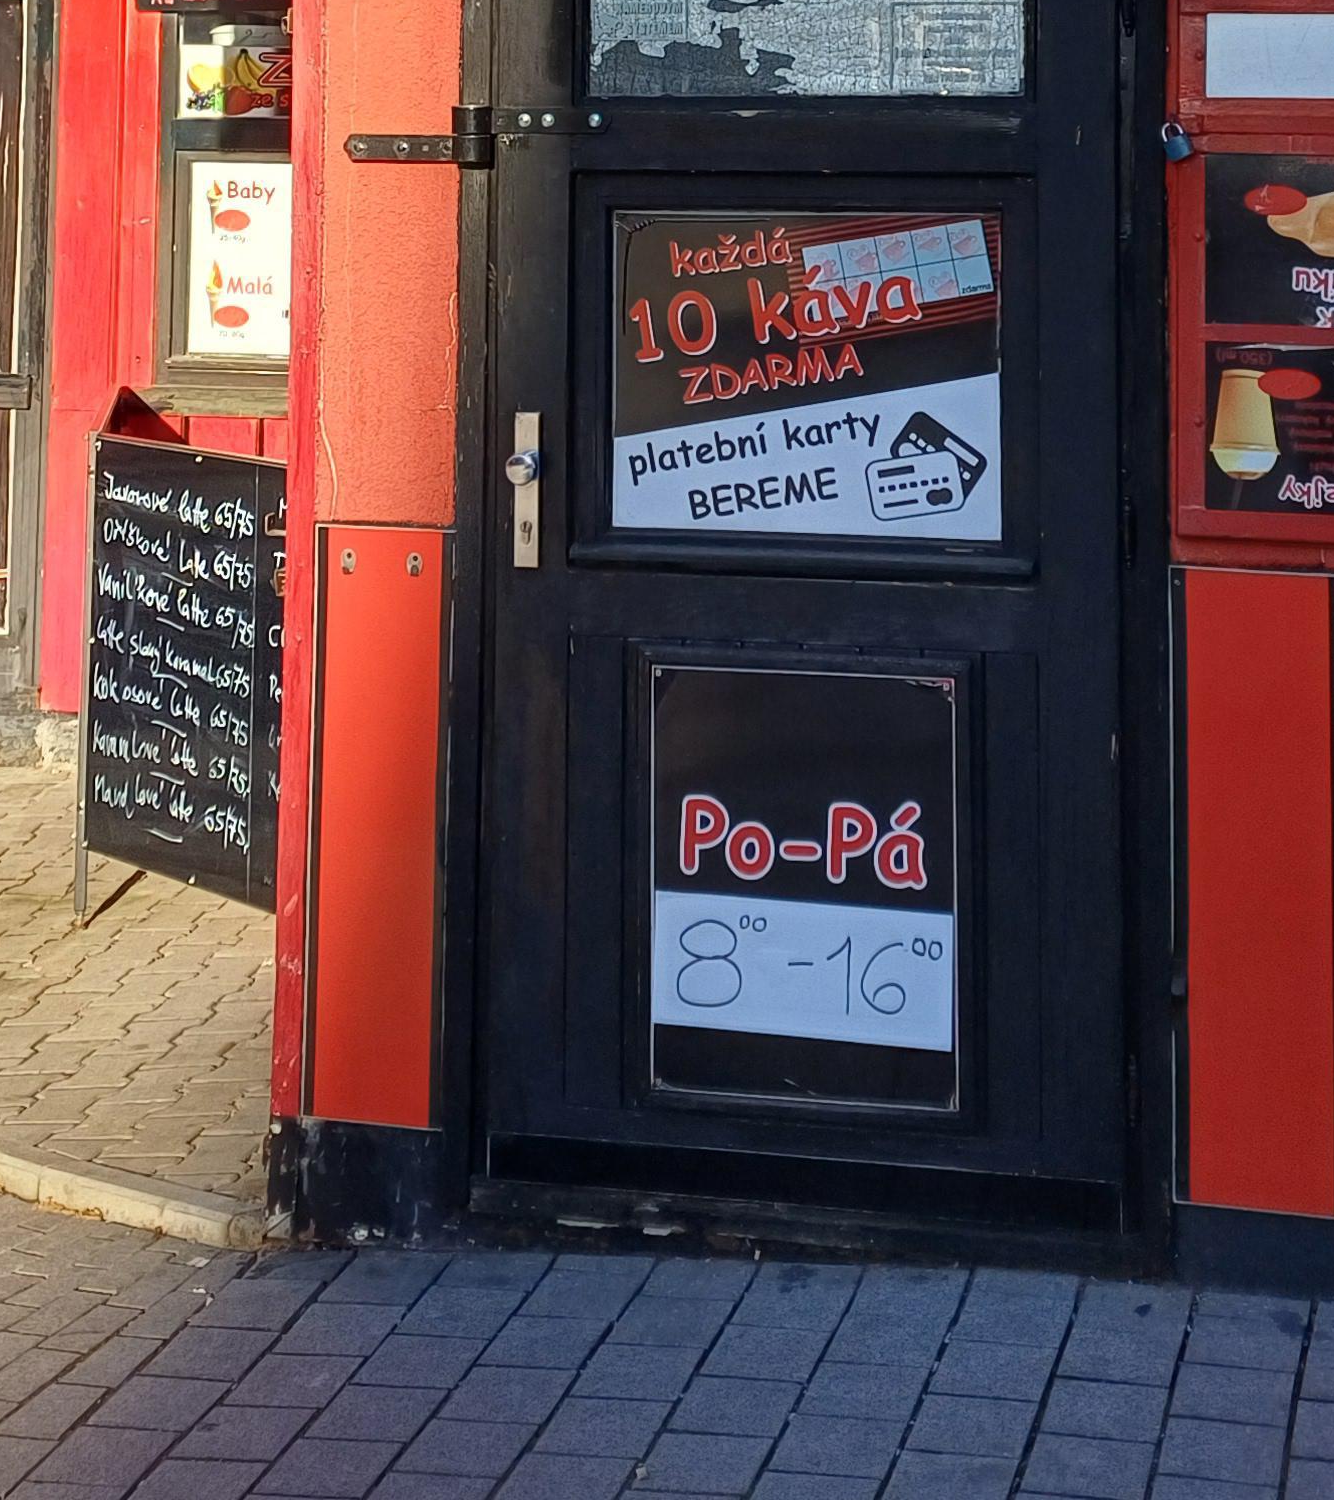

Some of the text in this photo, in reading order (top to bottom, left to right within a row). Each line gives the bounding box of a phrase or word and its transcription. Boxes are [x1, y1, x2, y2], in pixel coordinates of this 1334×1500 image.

[226, 180, 276, 205] Baby
[668, 227, 796, 279] každá
[226, 275, 274, 295] Malá
[960, 282, 992, 295] zdarma
[628, 265, 924, 364] 10 káva
[677, 343, 865, 405] ZDARMA
[628, 411, 881, 487] platební karty
[687, 467, 840, 521] BEREME
